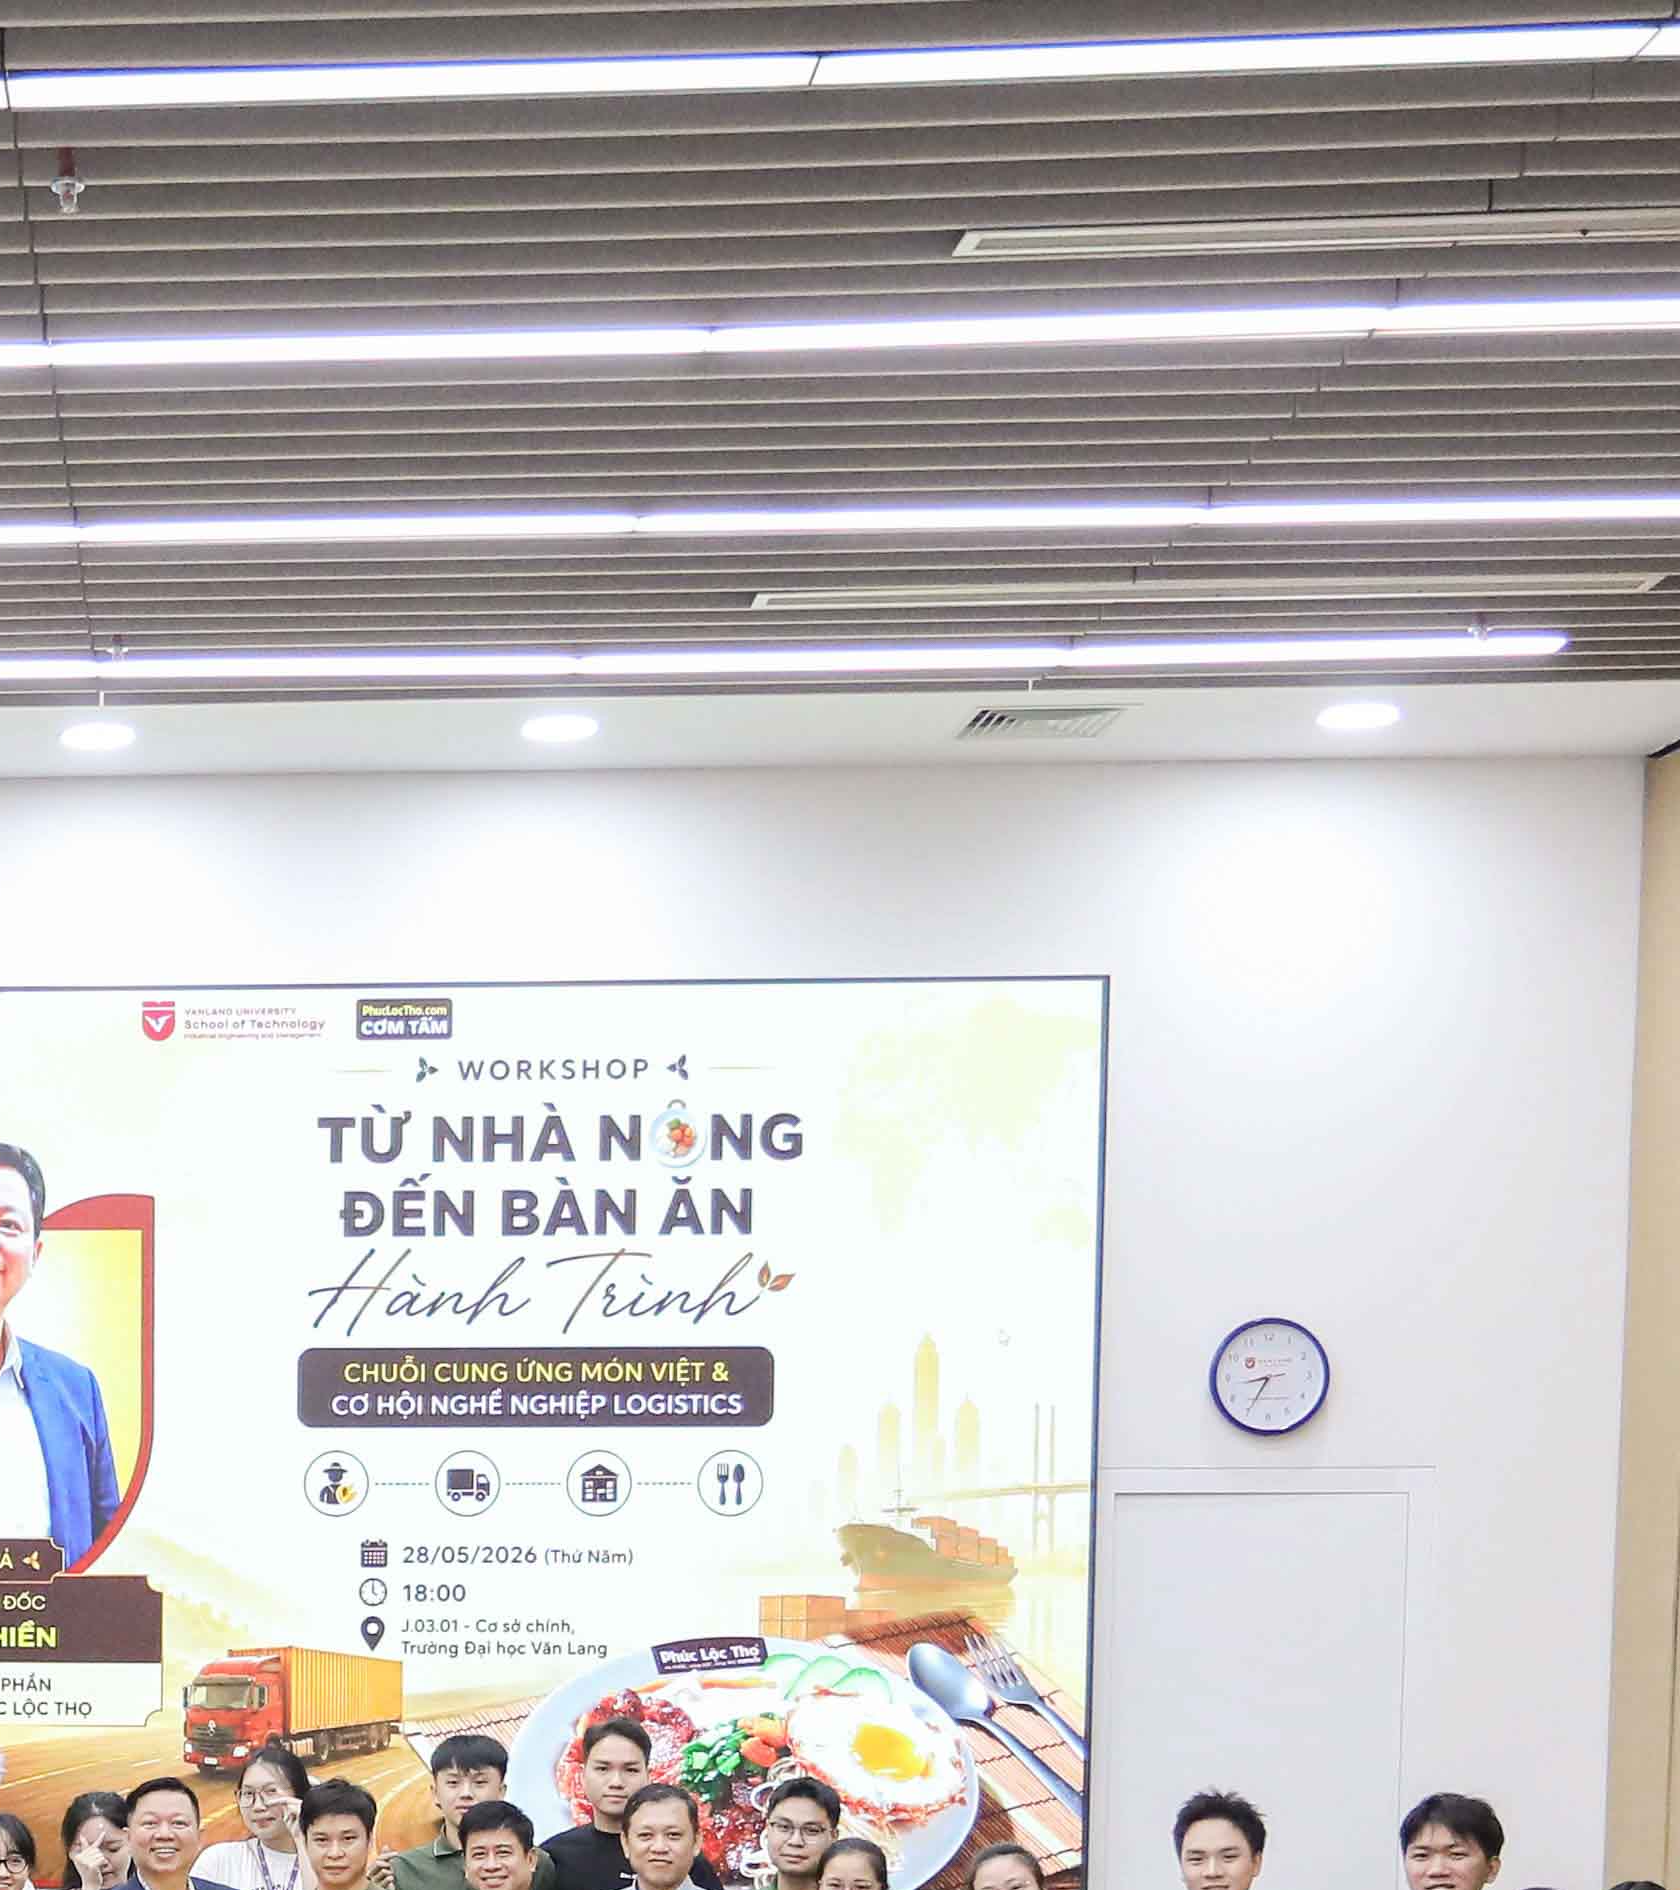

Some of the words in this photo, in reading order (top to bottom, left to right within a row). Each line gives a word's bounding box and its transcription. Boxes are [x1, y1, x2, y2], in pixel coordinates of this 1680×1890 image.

[185, 1019, 228, 1029] School
[233, 1019, 245, 1029] of
[248, 1019, 325, 1030] Technology
[458, 1059, 649, 1082] WORKSHOP
[317, 1104, 412, 1163] TỪ
[432, 1103, 576, 1162] NHÀ
[340, 1173, 475, 1237] ĐẾN
[501, 1176, 636, 1236] BÀN
[658, 1176, 753, 1235] ĂN
[308, 1248, 531, 1336] Hành
[546, 1248, 760, 1334] Trình
[344, 1356, 426, 1384] CHUỖI
[433, 1363, 508, 1383] CUNG
[516, 1357, 573, 1383] ỨNG
[581, 1357, 643, 1382] MÓN
[650, 1358, 706, 1387] VIỆT
[712, 1363, 729, 1382] &
[331, 1393, 373, 1416] CƠ
[377, 1391, 423, 1420] HỘI
[430, 1387, 502, 1415] NGHỀ
[510, 1390, 607, 1420] NGHIỆP
[614, 1393, 743, 1416] LOGISTICS
[402, 1546, 537, 1566] 28/05/2026
[544, 1548, 583, 1566] (Thứ
[587, 1548, 634, 1566] Năm)
[2, 1589, 46, 1611] ĐỐC
[402, 1584, 466, 1603] 18:00
[402, 1619, 459, 1634] J.03.01
[476, 1619, 498, 1634] Cơ
[527, 1617, 575, 1636] chính,
[402, 1639, 459, 1659] Trường
[530, 1640, 562, 1655] Văn
[567, 1641, 608, 1659] Lang
[13, 1697, 49, 1718] LỘC
[54, 1701, 93, 1719] THỌ
